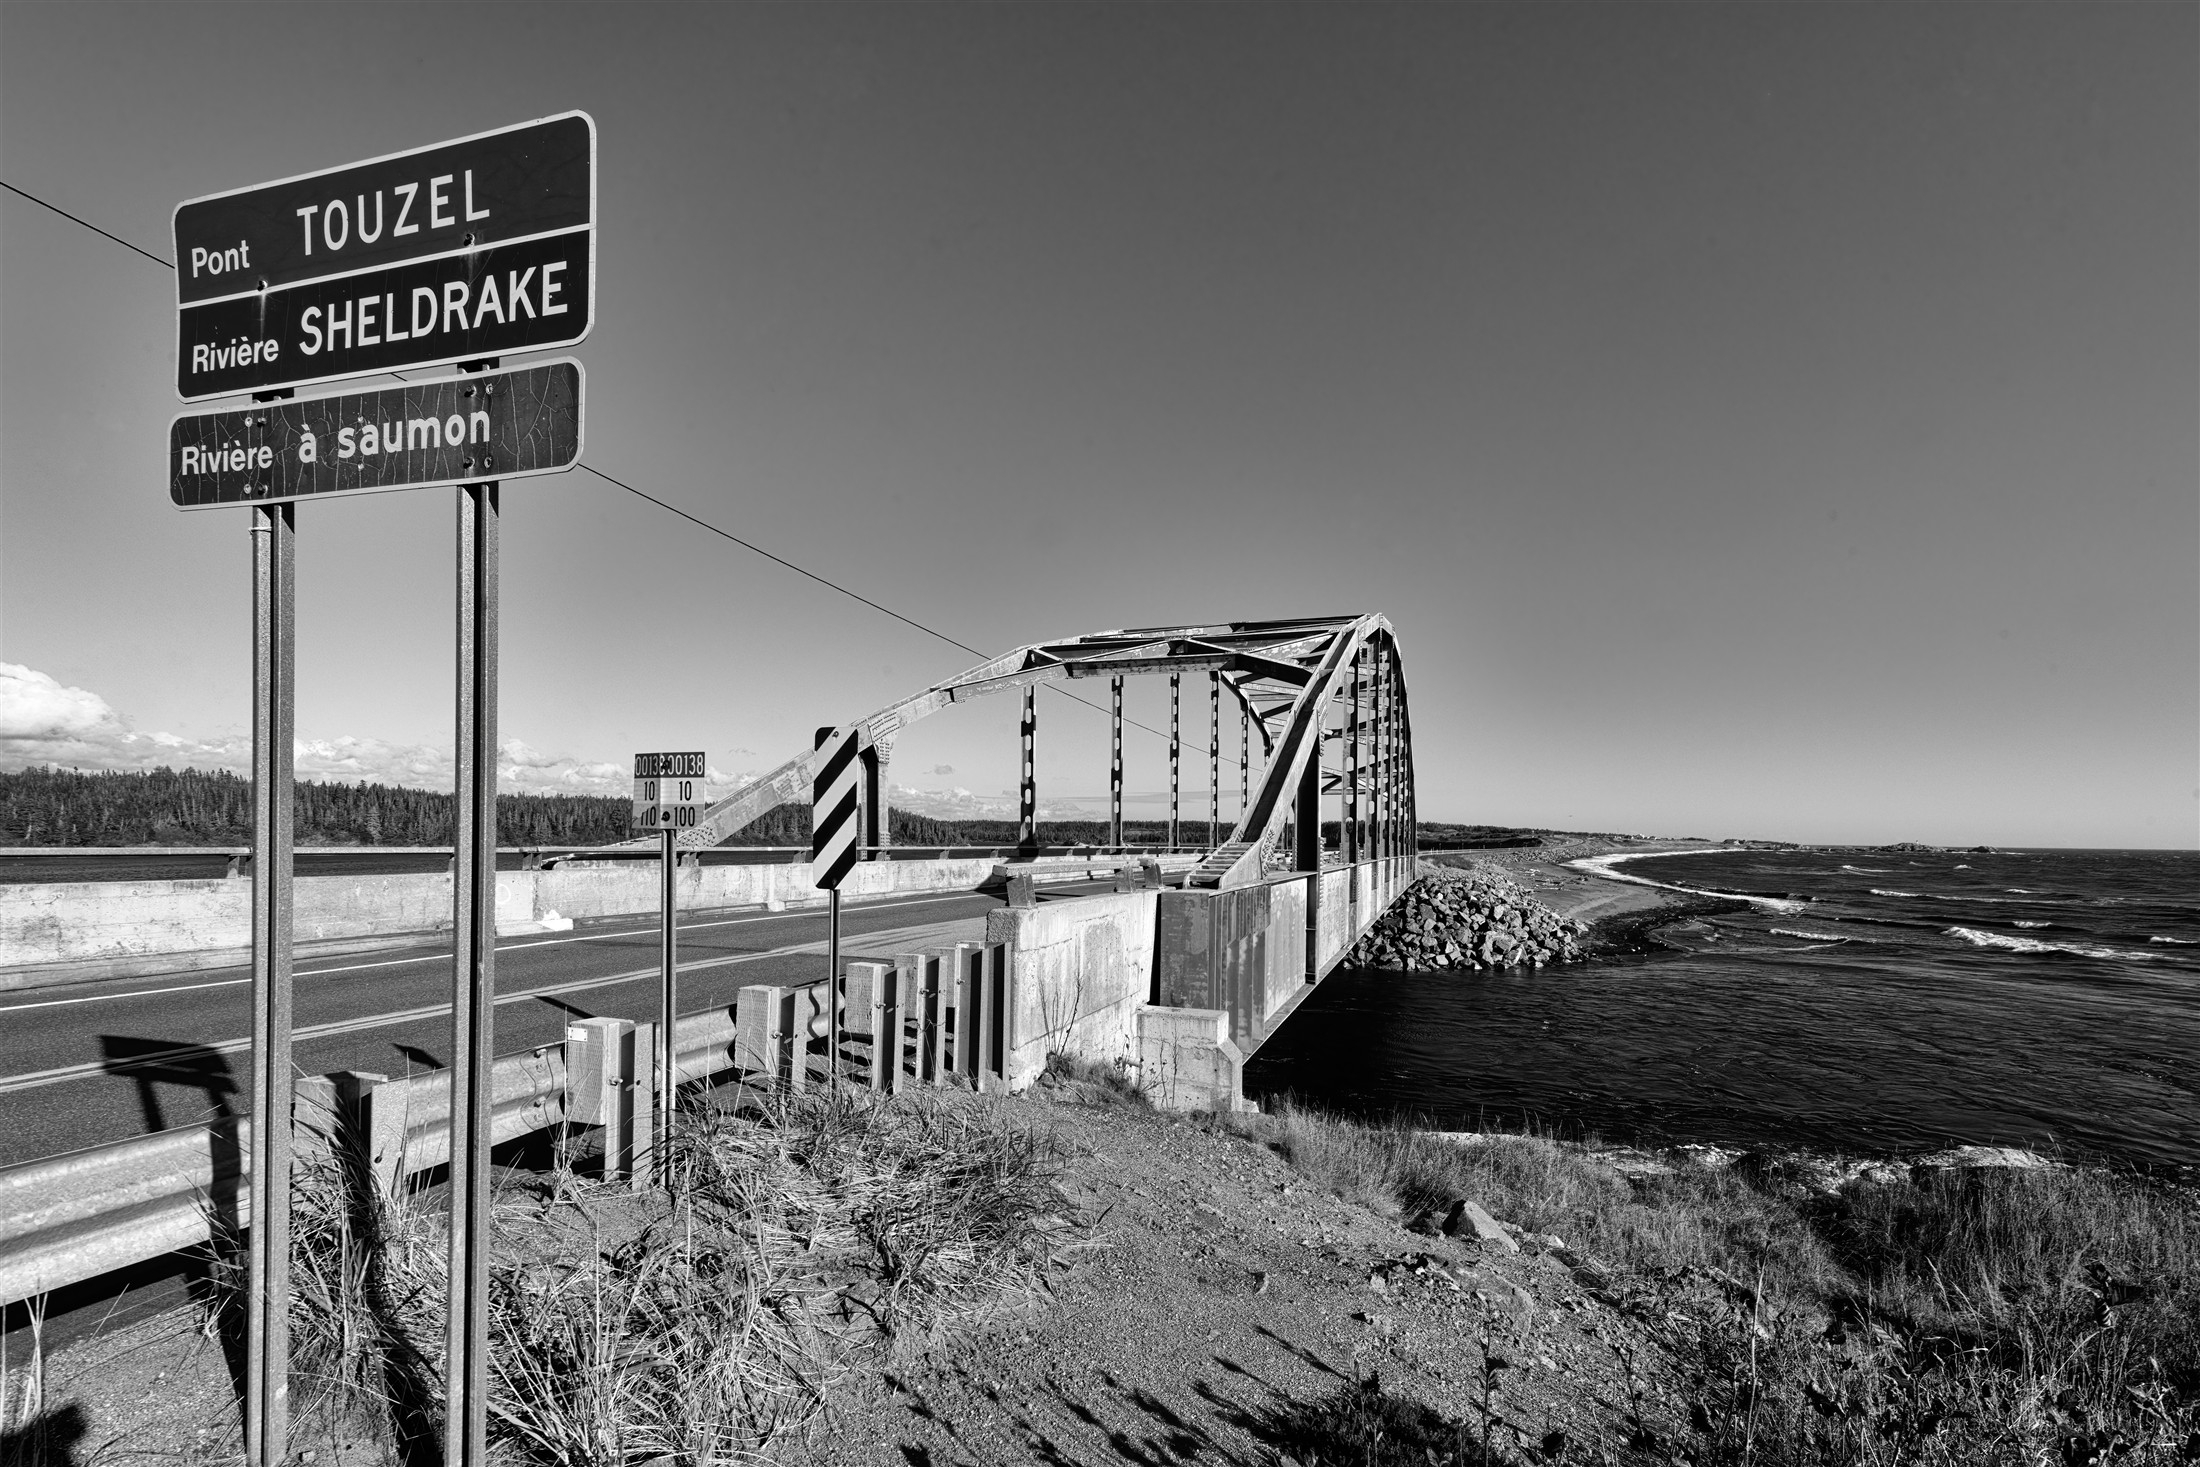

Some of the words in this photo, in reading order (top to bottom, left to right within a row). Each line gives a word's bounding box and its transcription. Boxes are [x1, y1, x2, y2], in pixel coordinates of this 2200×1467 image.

[191, 240, 250, 278] Pont
[297, 169, 490, 256] TOUZEL
[192, 336, 279, 374] Rivière
[299, 261, 568, 356] SHELDRAKE
[181, 440, 273, 476] Rivière
[299, 422, 317, 463] à
[337, 410, 491, 459] saumon
[644, 780, 655, 801] 10
[679, 780, 692, 801] 10
[674, 806, 695, 827] 100
